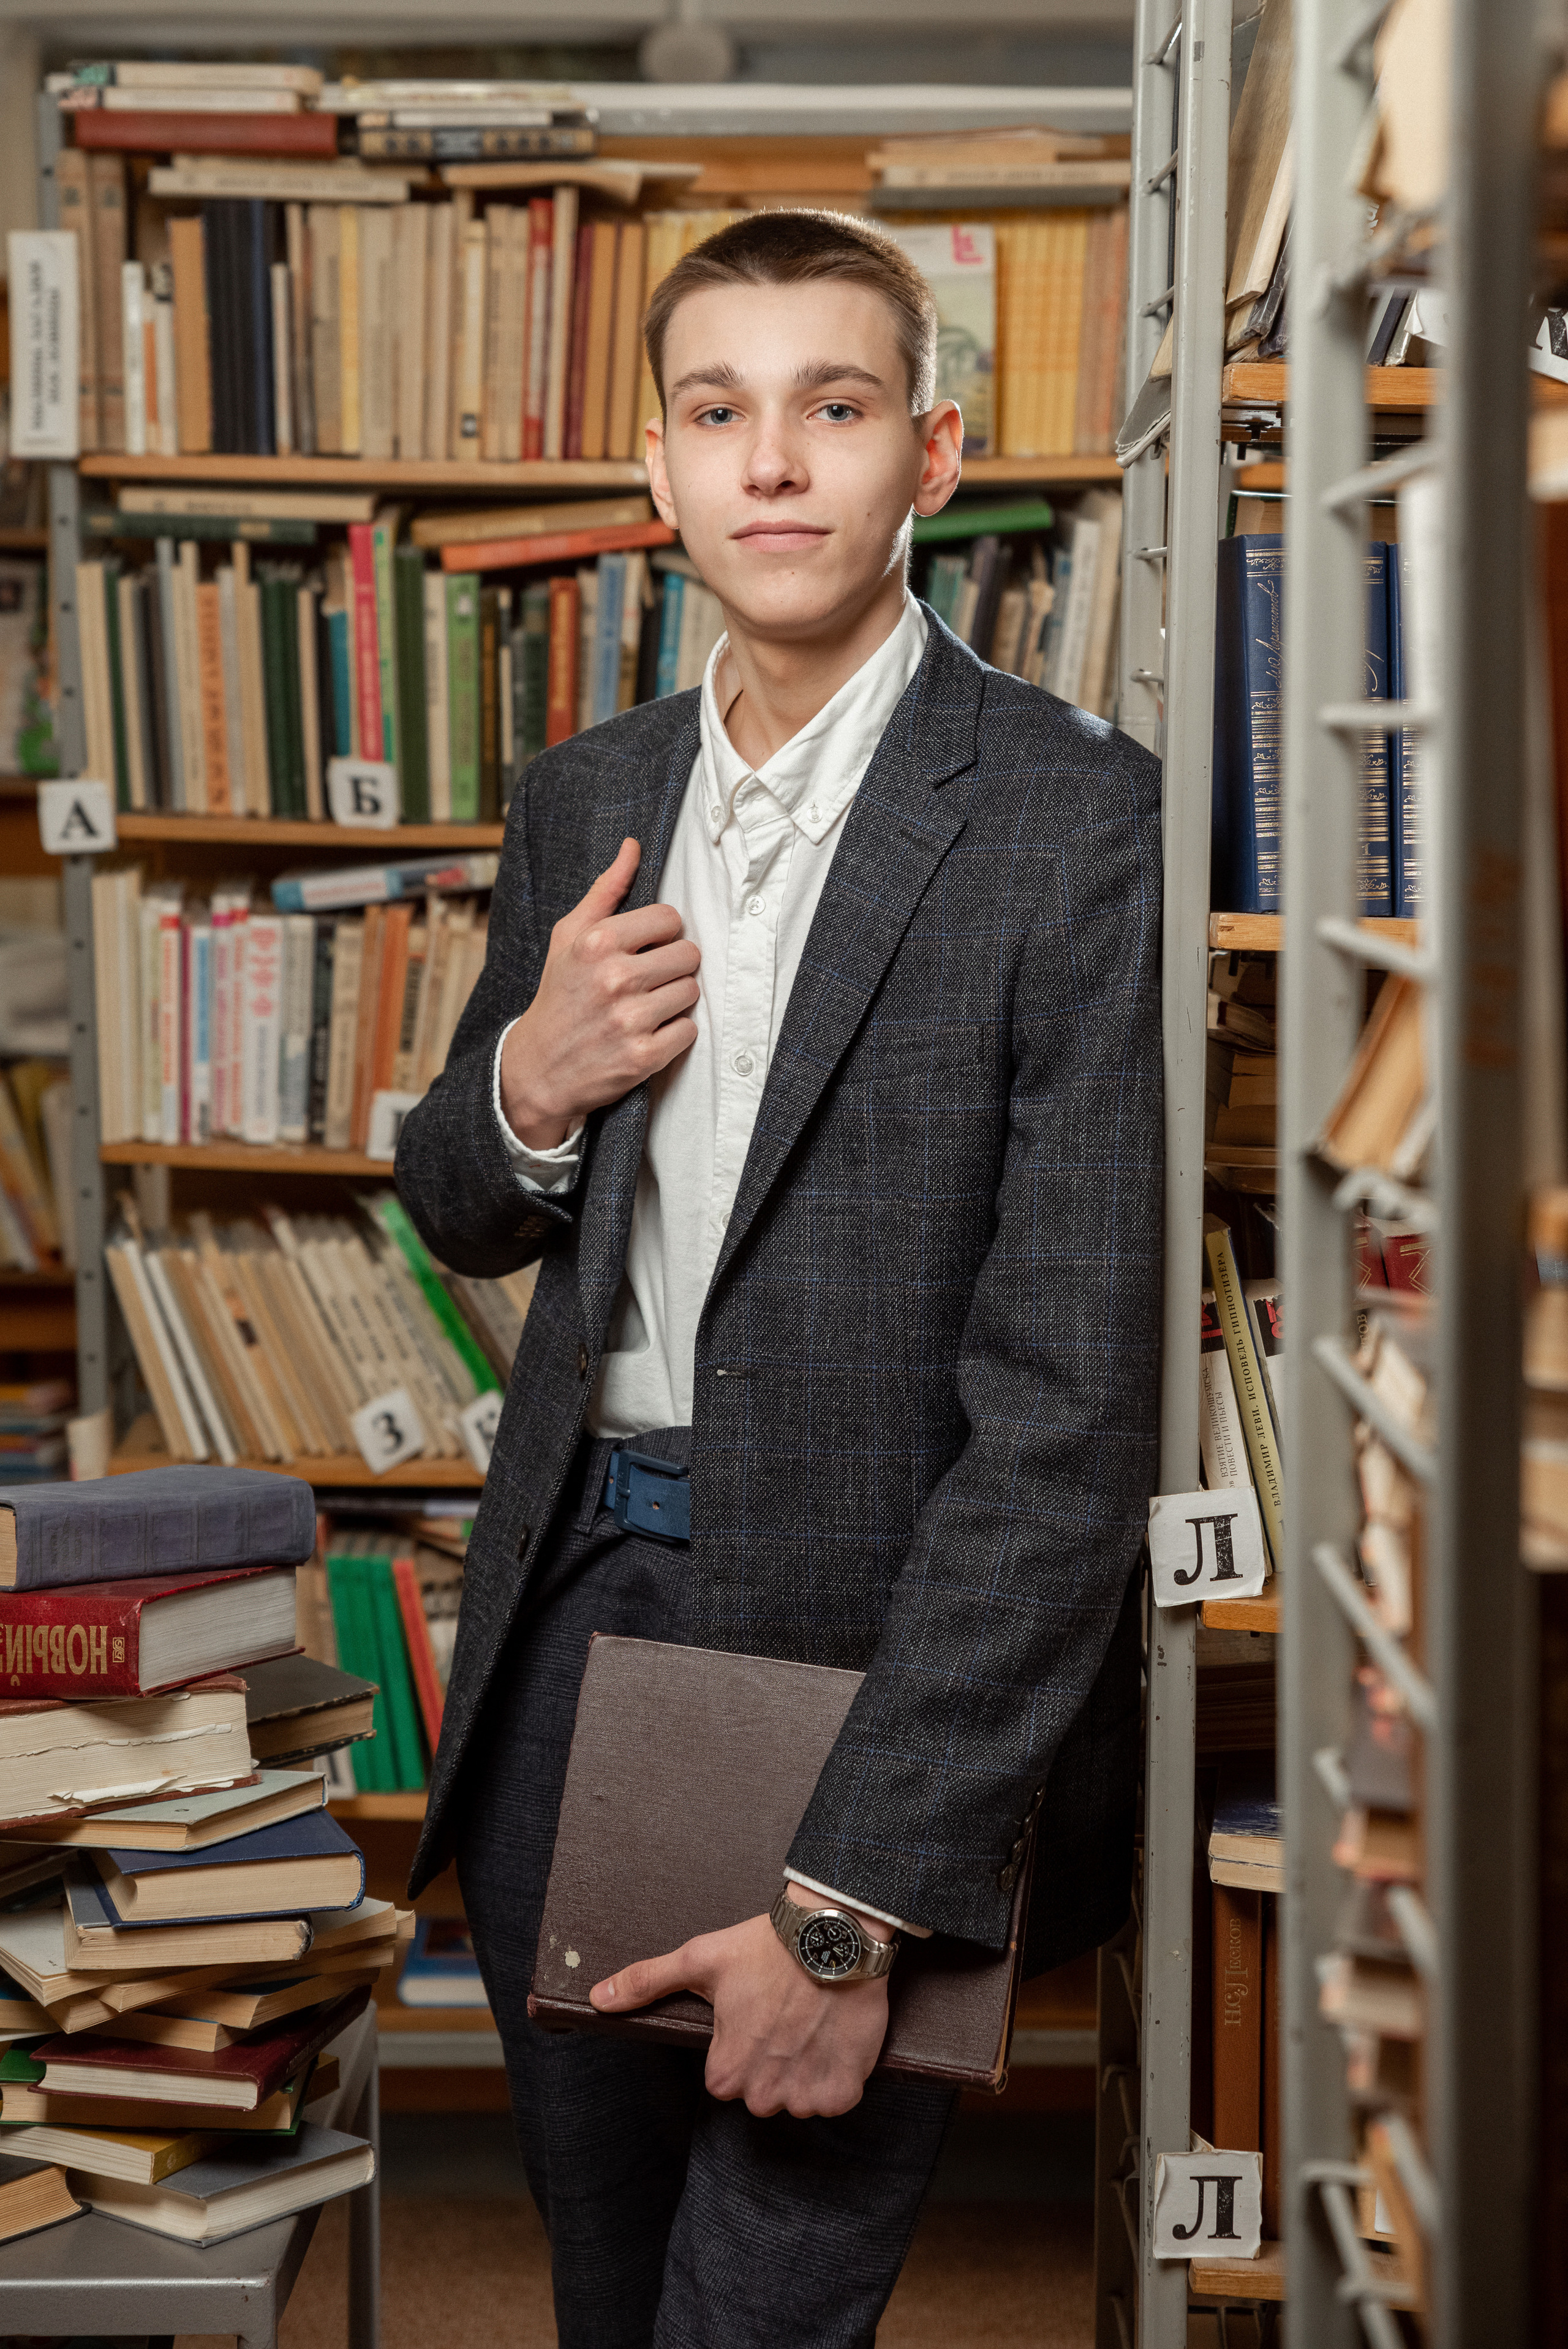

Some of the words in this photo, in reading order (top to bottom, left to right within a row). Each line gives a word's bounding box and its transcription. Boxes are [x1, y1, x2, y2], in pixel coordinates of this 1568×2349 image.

[60, 799, 99, 840] А
[350, 774, 383, 815] Б
[1216, 1252, 1242, 1335] ГИПНОТИЗЁРА
[1237, 1339, 1256, 1401] ИСПОВЕДЬ
[1215, 1391, 1228, 1423] ПЬЕСЫ
[1252, 1405, 1265, 1439] ЛЕВИ.
[1216, 1443, 1229, 1478] ВЗЯТИЕ
[1224, 1434, 1238, 1477] ПОВЕСТИ
[1261, 1444, 1281, 1507] ВЛАДИМИР
[1174, 1513, 1243, 1586] Л
[5, 1624, 108, 1686] НОВЫЙ
[1172, 2176, 1243, 2240] Л
